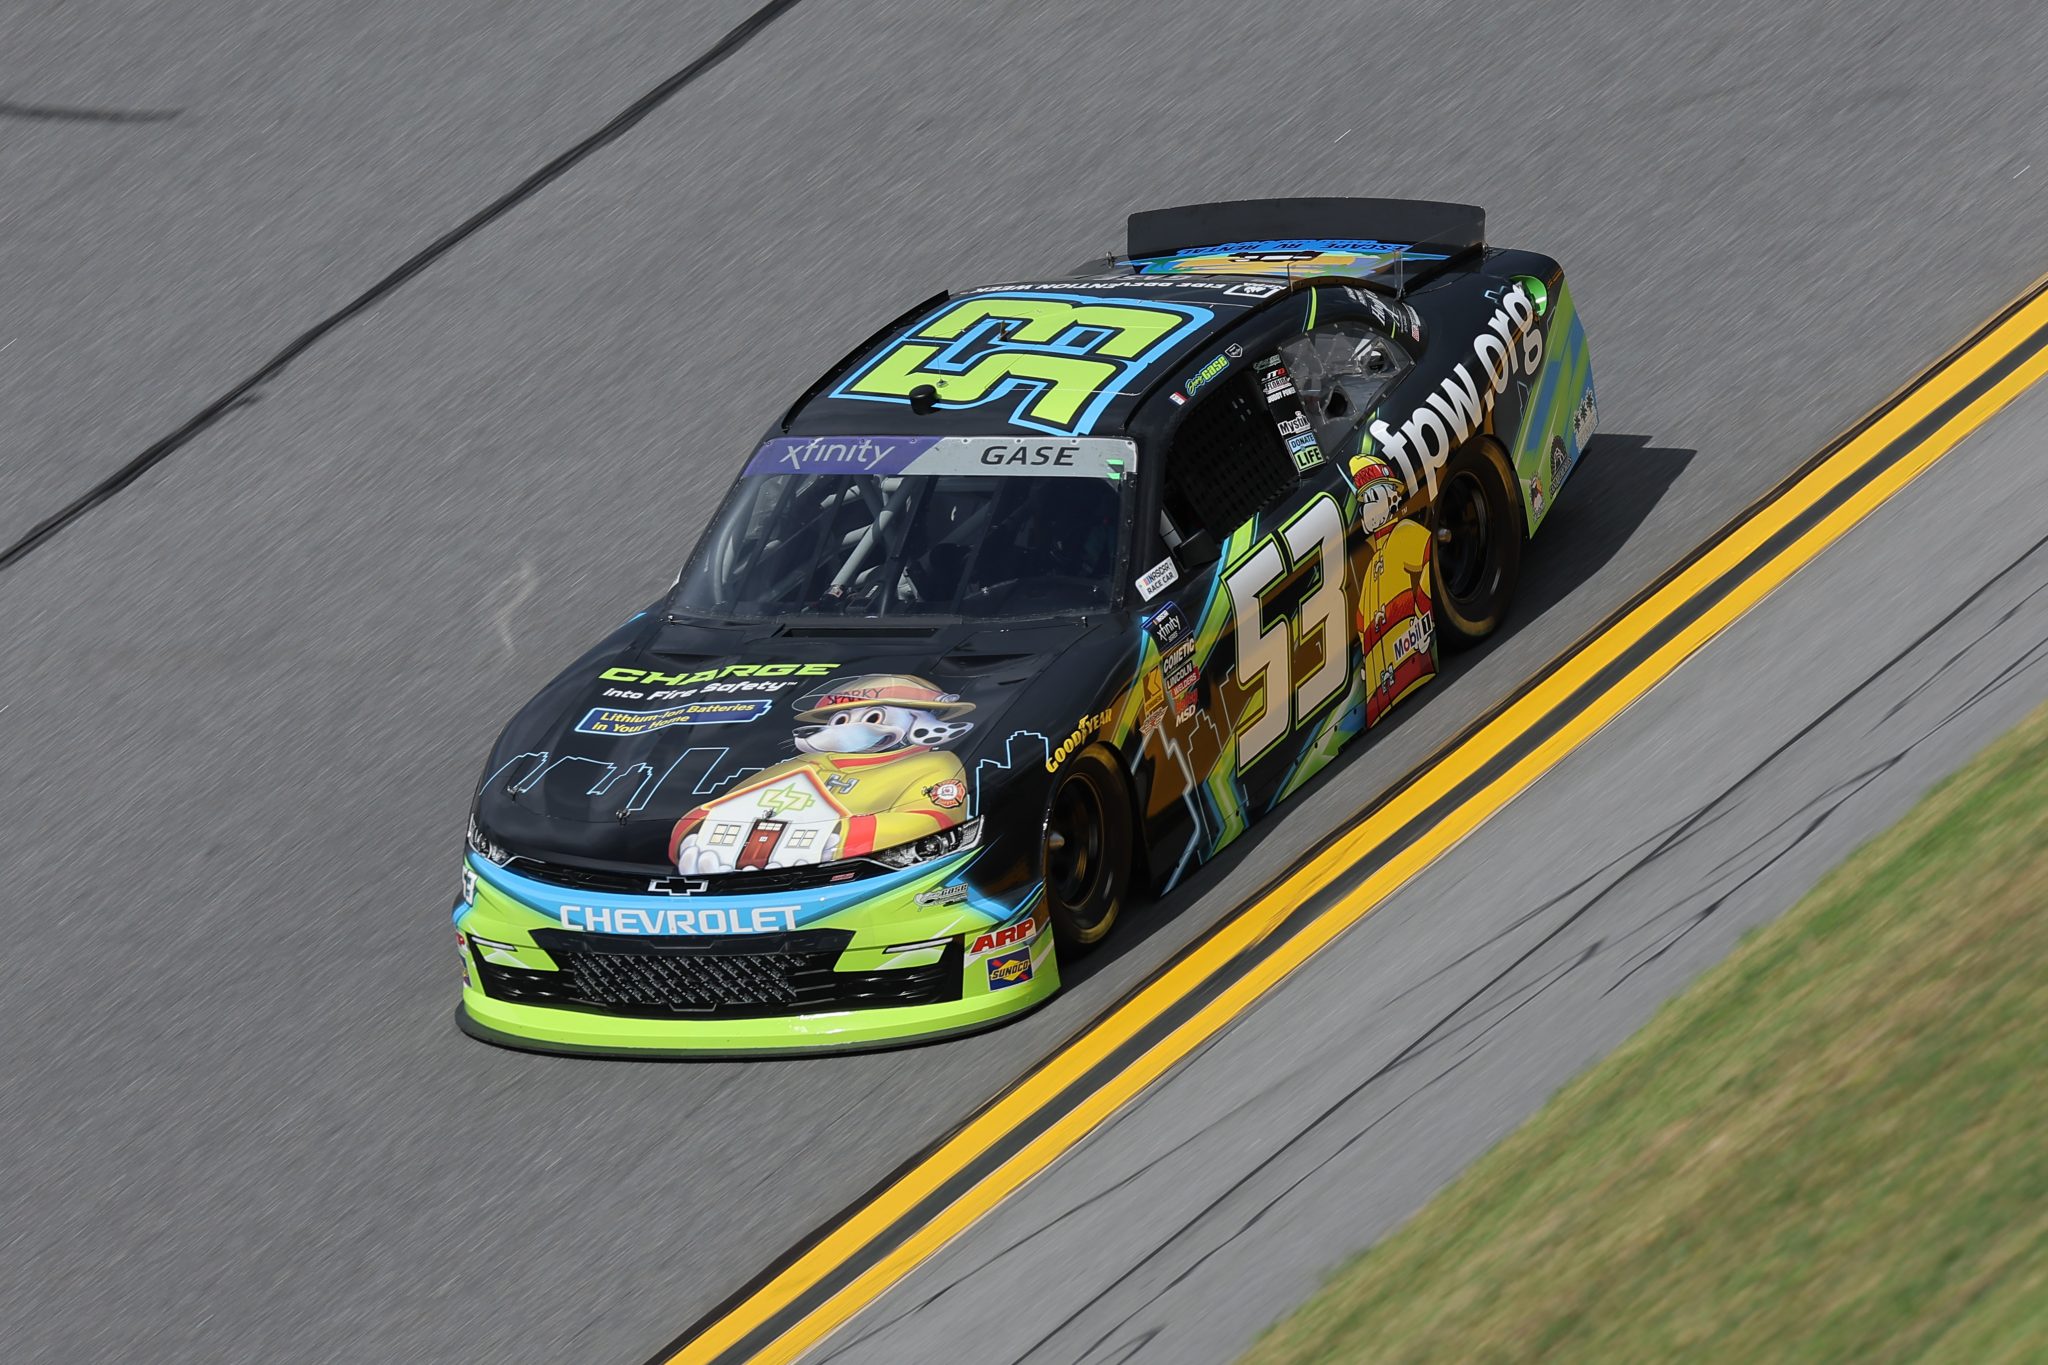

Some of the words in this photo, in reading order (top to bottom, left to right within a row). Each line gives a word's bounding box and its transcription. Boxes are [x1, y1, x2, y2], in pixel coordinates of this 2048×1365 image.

[1369, 281, 1543, 502] fpw.org
[1290, 434, 1315, 449] DONATE
[778, 437, 896, 471] xfinity
[980, 445, 1080, 467] GASE
[1296, 448, 1322, 467] LIFE
[1146, 562, 1171, 584] NASCAR
[1146, 580, 1163, 595] RACE
[1162, 571, 1175, 585] CAR
[1156, 615, 1181, 642] xfinity
[1223, 492, 1350, 776] 53
[1394, 622, 1422, 661] Mobil
[1163, 638, 1195, 673] COMETIC
[598, 663, 842, 687] CHARGE
[1166, 662, 1194, 690] LINCOLN
[647, 686, 699, 701] Fire
[686, 702, 756, 714] Batteries
[1175, 704, 1197, 728] MSD
[612, 722, 646, 734] Your
[648, 714, 691, 731] Home
[1045, 708, 1112, 773] GOODYEAR
[559, 904, 802, 935] CHEVROLET
[971, 919, 1035, 954] ARP
[991, 961, 1029, 980] SUNOCO
